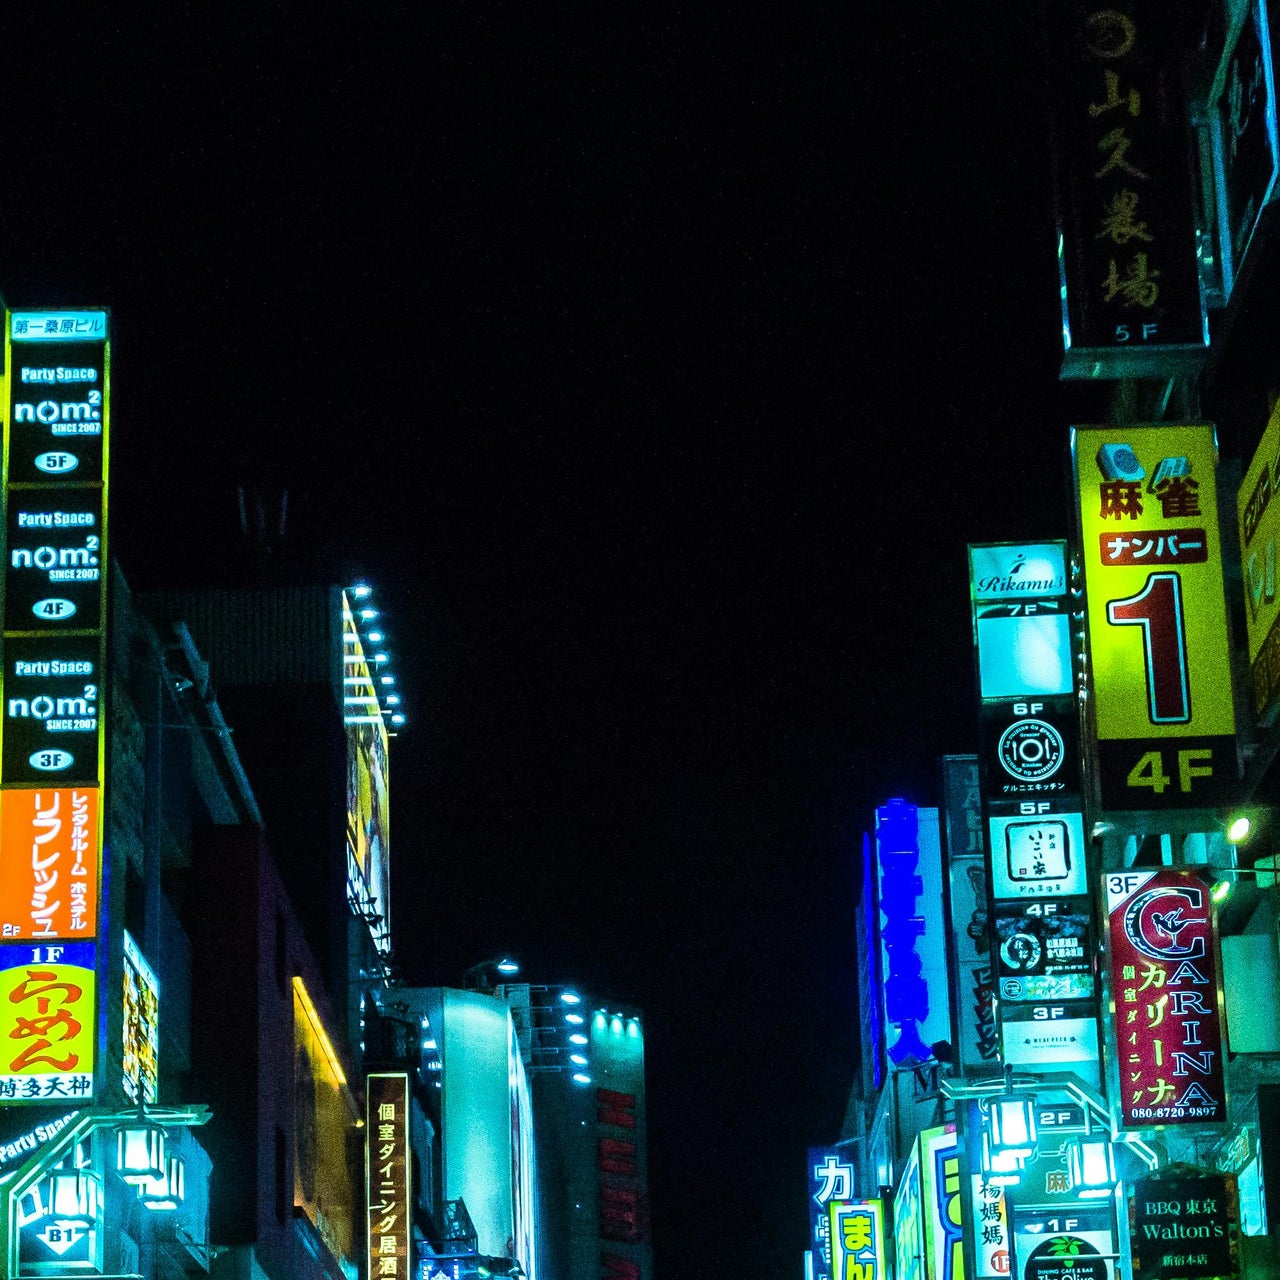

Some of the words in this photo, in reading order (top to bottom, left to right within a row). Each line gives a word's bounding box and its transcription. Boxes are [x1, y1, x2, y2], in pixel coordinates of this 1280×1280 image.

[13, 319, 103, 334] 第一桑原ビル
[21, 367, 55, 383] Party
[56, 367, 97, 383] Space
[46, 456, 68, 468] 5F
[1099, 478, 1202, 520] 麻雀
[18, 512, 53, 527] Party
[54, 512, 94, 527] Space
[1107, 536, 1202, 559] ナンバー
[43, 603, 64, 615] 4F
[1007, 604, 1038, 616] 7F
[1105, 571, 1193, 726] 1
[16, 661, 50, 676] Party
[51, 661, 93, 676] Space
[1013, 703, 1044, 715] 6F
[40, 753, 62, 767] 3F
[1126, 748, 1214, 793] 4F
[1002, 782, 1066, 792] グルニエキッチン
[1020, 802, 1051, 814] 5F
[71, 792, 87, 876] レンタルルーム
[31, 793, 61, 938] リフレッシュ
[1109, 876, 1139, 894] 3F
[70, 882, 88, 931] ホステル
[1026, 904, 1057, 916] 4F
[2, 923, 21, 937] 2F
[31, 946, 64, 963] 1F
[1123, 886, 1218, 1106] CARINA
[1033, 1007, 1064, 1020] 3F
[9, 970, 83, 1074] らーめん
[1121, 965, 1144, 1105] 個室ダイニング
[1139, 963, 1176, 1106] カリーナ
[1040, 1112, 1071, 1125] 2F
[1131, 1107, 1217, 1119] 080-8720-9897
[1145, 1201, 1181, 1216] BBQ
[1185, 1199, 1217, 1215] 東京
[1047, 1219, 1078, 1231] 1F
[1142, 1219, 1224, 1240] Walton's
[49, 1229, 73, 1242] B1
